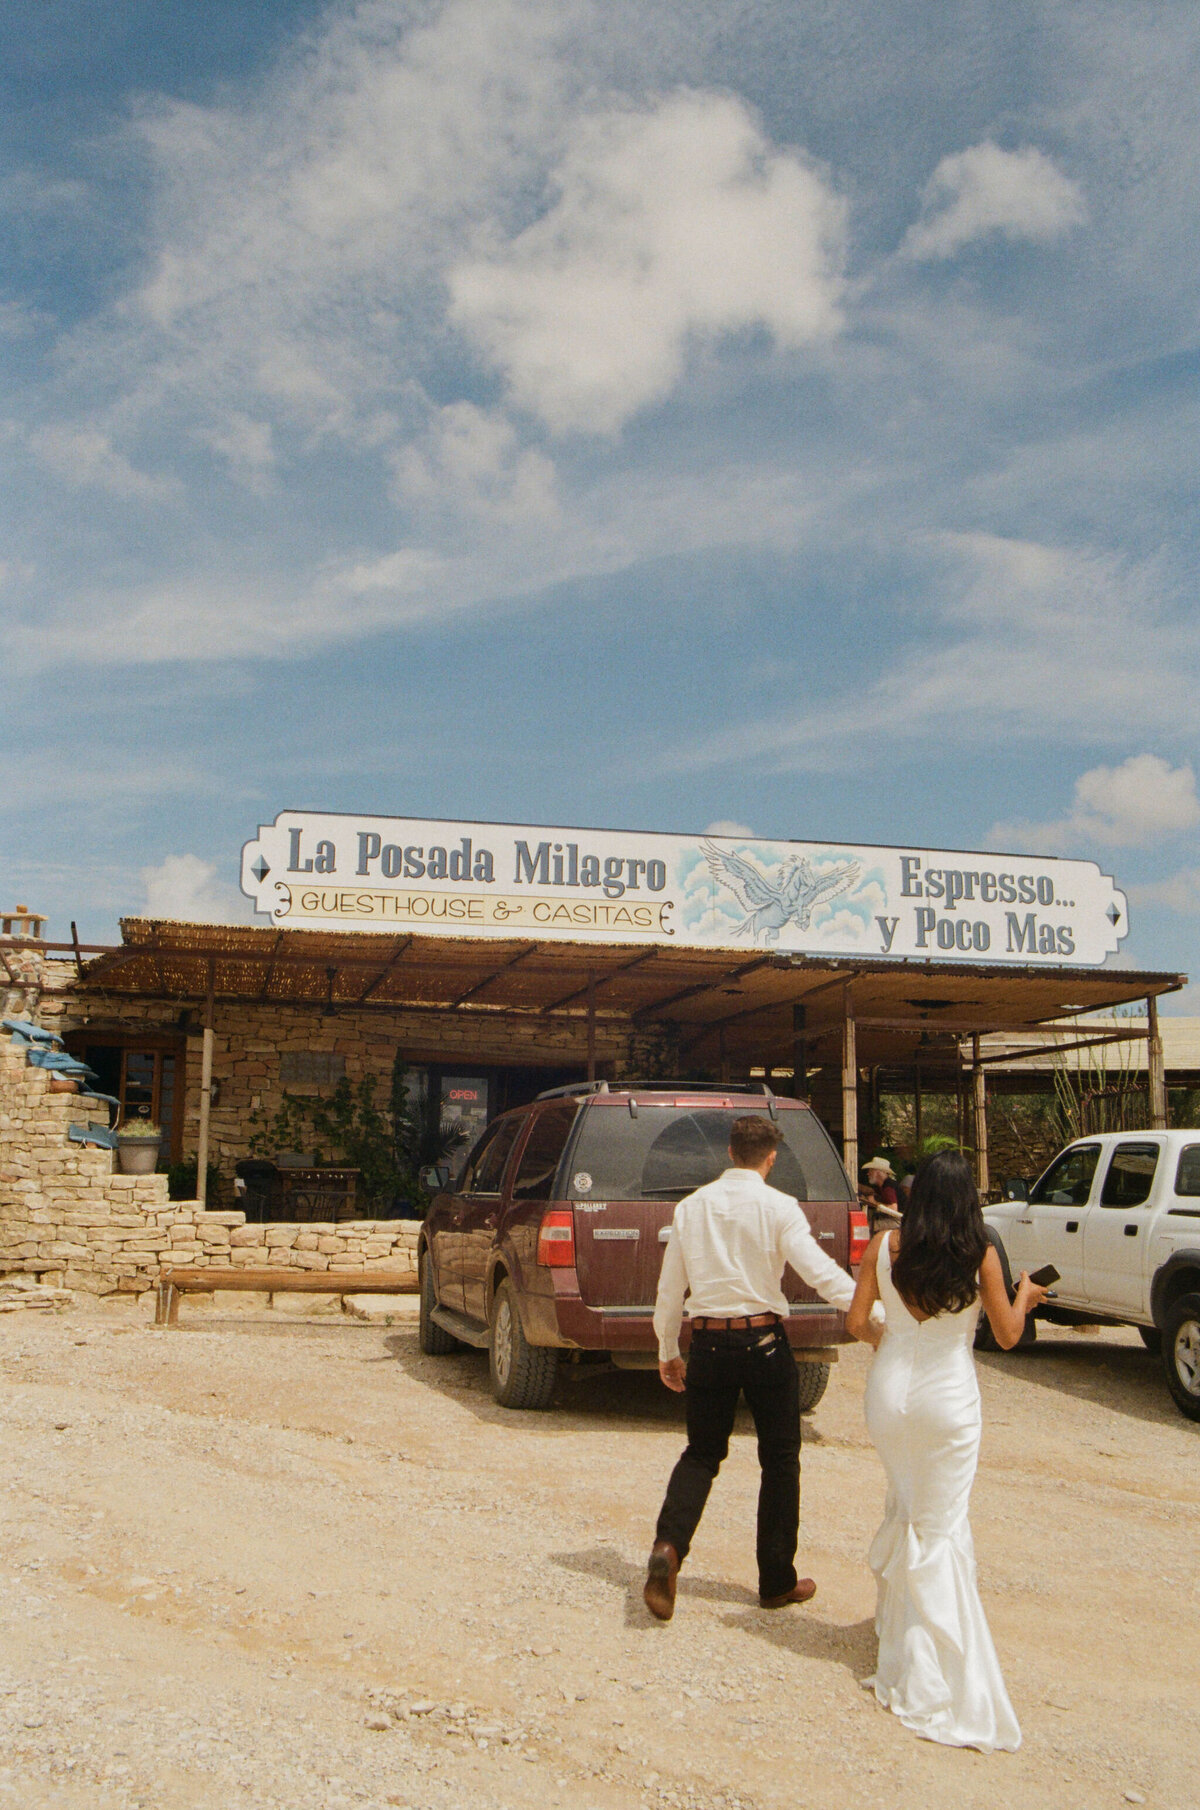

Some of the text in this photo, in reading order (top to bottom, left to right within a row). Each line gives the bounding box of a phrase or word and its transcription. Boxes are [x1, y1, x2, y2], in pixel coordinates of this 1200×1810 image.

[287, 828, 667, 899] La Posada Milagro
[899, 856, 1076, 911] Espresso...
[301, 891, 653, 927] GUESTHOUSE & CASITAS
[874, 906, 1076, 956] y Poco Mas
[449, 1089, 478, 1100] OPEN
